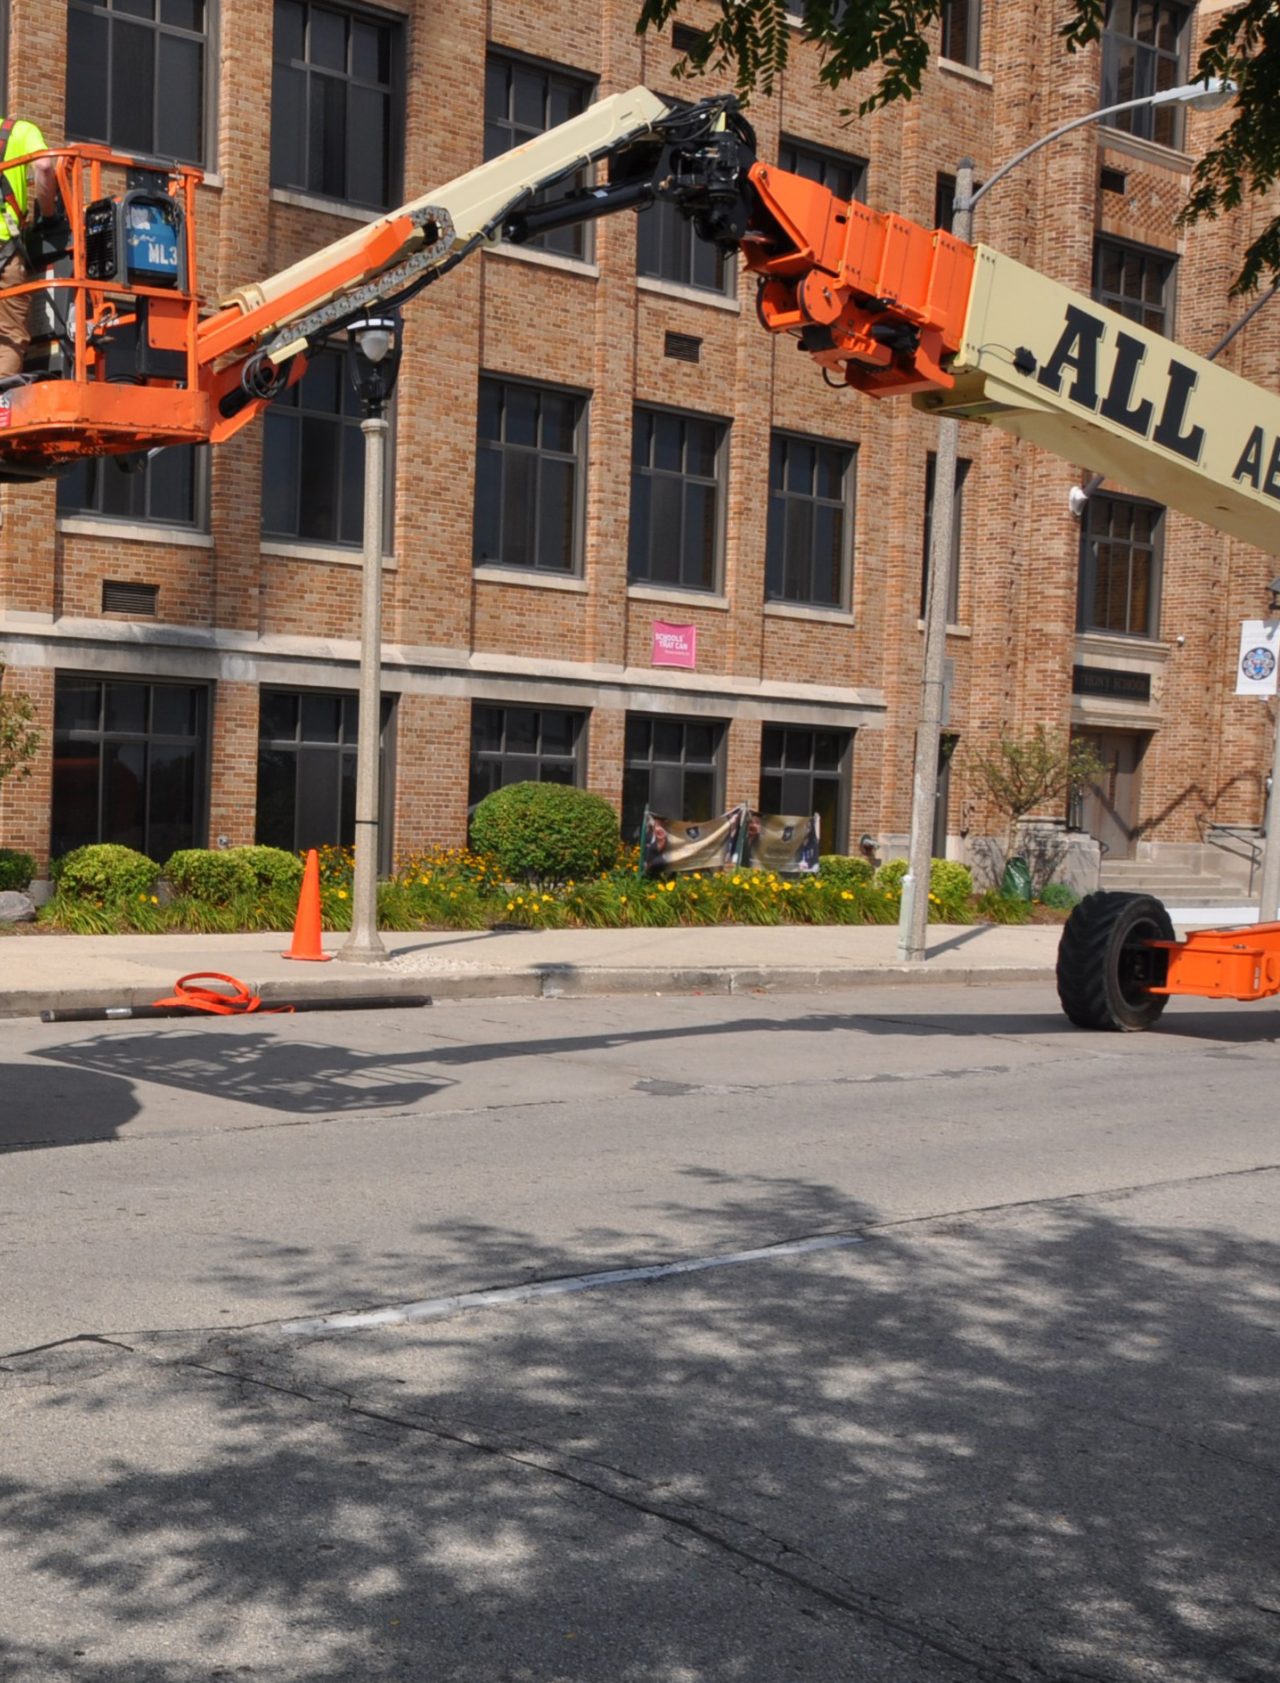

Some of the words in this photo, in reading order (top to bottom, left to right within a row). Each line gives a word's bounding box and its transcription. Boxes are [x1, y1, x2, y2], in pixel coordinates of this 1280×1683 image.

[1037, 303, 1206, 464] ALL
[655, 632, 683, 642] SCHOOLS
[659, 641, 674, 649] THAT
